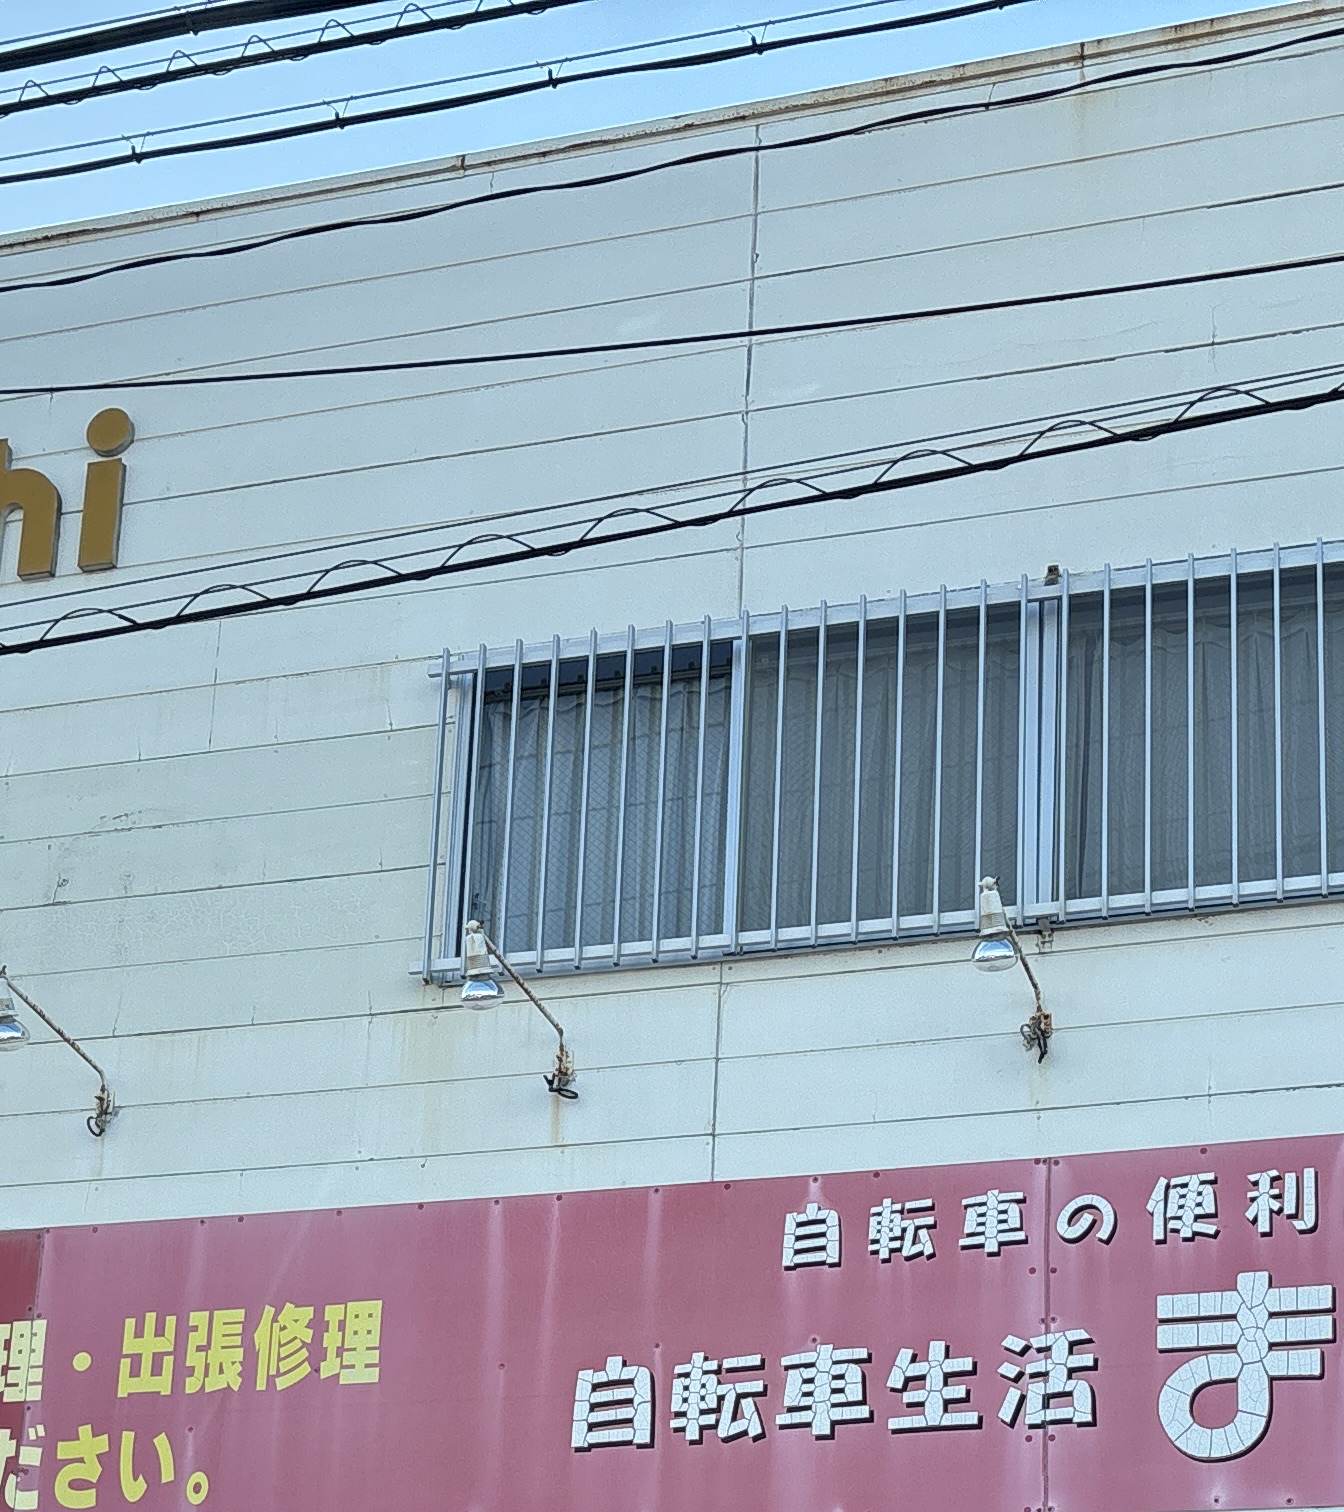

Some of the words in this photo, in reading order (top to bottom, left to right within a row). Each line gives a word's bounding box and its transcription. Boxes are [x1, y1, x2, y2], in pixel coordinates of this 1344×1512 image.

[570, 1327, 1100, 1454] 自転車生活
